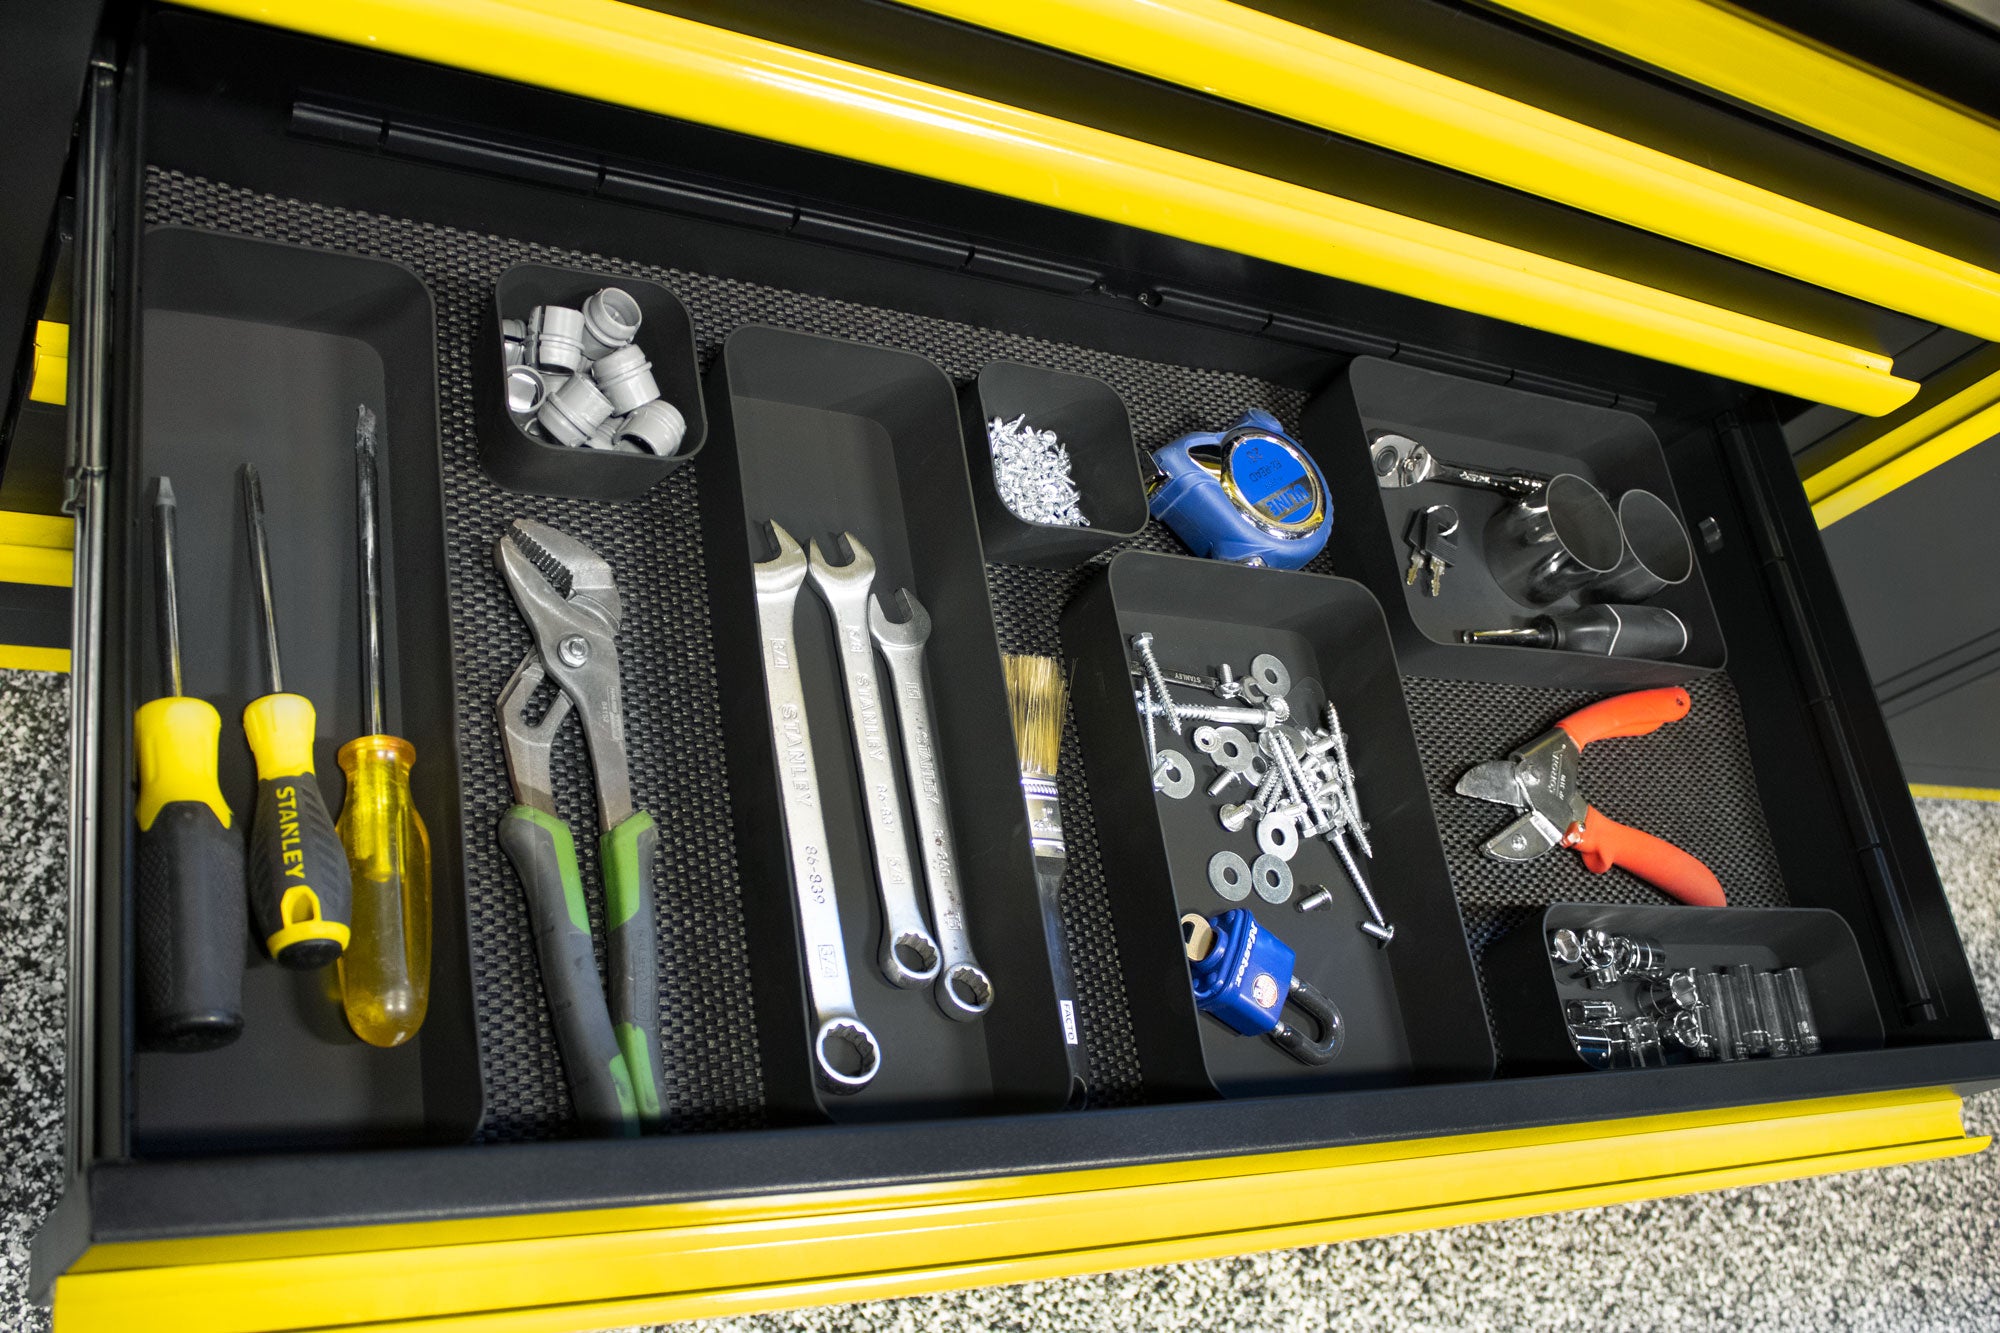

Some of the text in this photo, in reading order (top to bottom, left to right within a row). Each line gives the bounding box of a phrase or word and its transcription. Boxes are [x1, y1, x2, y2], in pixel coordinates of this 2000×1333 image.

[1266, 484, 1310, 517] ULINE
[1174, 672, 1202, 684] STANLEY
[855, 671, 885, 762] STANLEY
[916, 731, 940, 804] STANLEY
[275, 785, 306, 880] STANLEY
[781, 703, 826, 905] STANLEY 86-839
[1235, 920, 1258, 988] Master
[1063, 1003, 1075, 1041] FACTO
